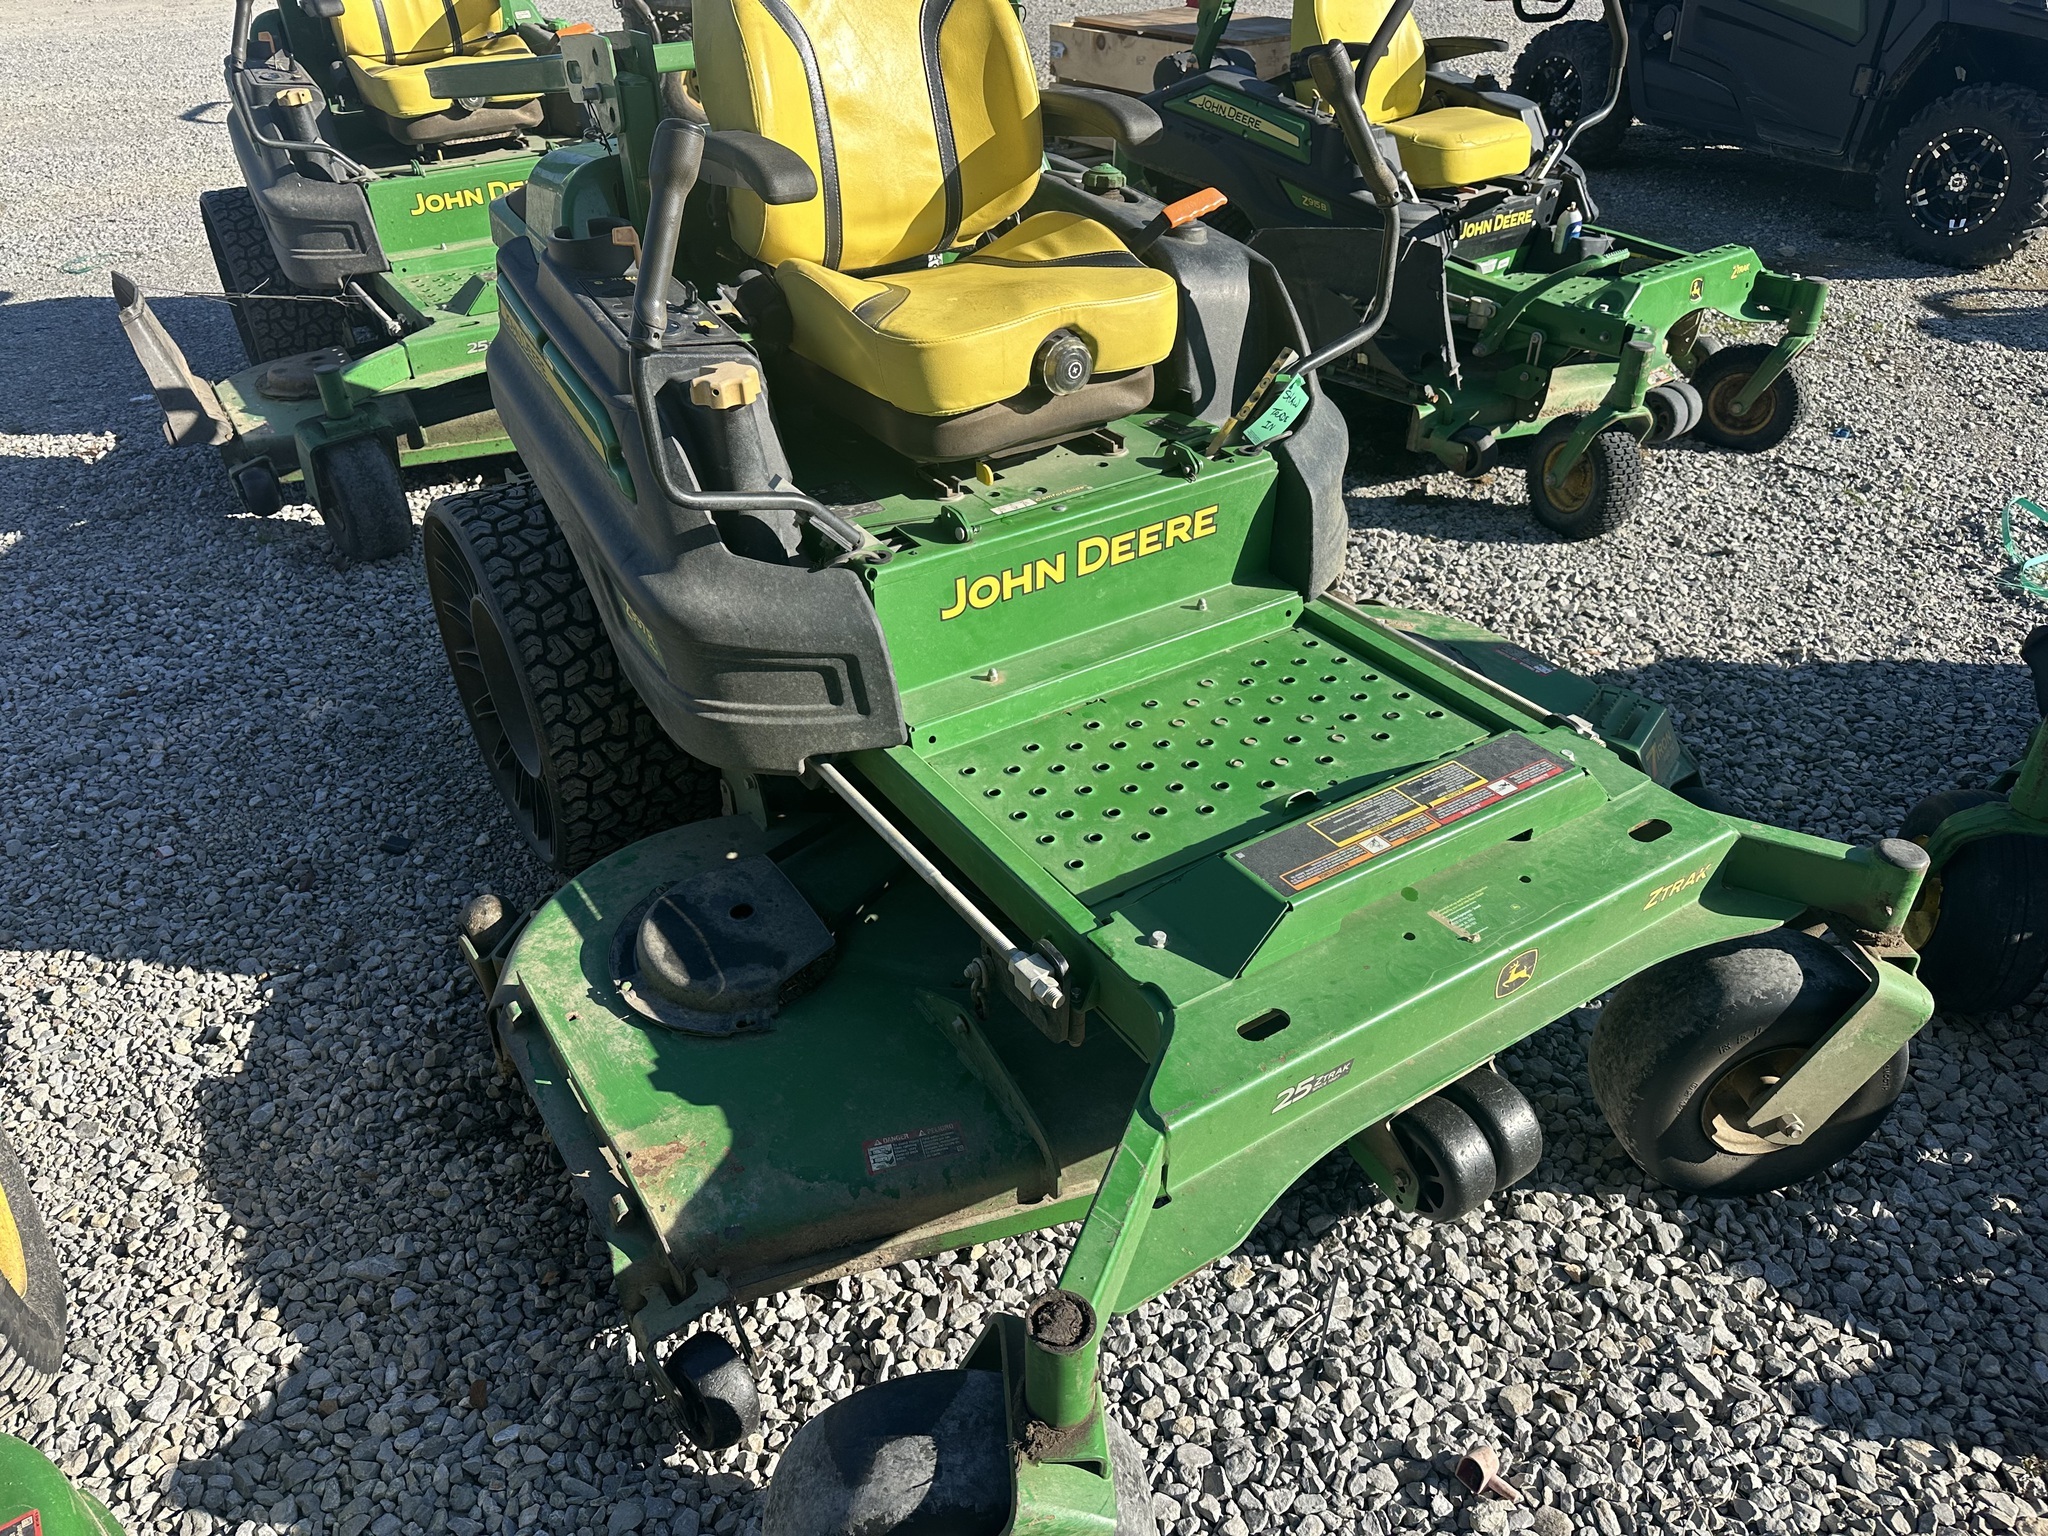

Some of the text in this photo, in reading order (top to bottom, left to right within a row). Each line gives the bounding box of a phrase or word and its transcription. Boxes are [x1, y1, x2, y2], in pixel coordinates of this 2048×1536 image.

[1198, 97, 1262, 130] JOHN DEERE
[410, 187, 484, 216] JOHN
[1458, 208, 1534, 240] JOHN DEERE
[466, 340, 489, 355] 25
[1261, 420, 1277, 431] IN
[940, 503, 1219, 622] JOHN DEERE
[1643, 863, 1712, 911] ZTRAK
[1271, 1074, 1316, 1115] 25
[1314, 1062, 1351, 1087] ZTRAK
[883, 1133, 910, 1144] DANGER
[927, 1123, 954, 1135] PELIGRO
